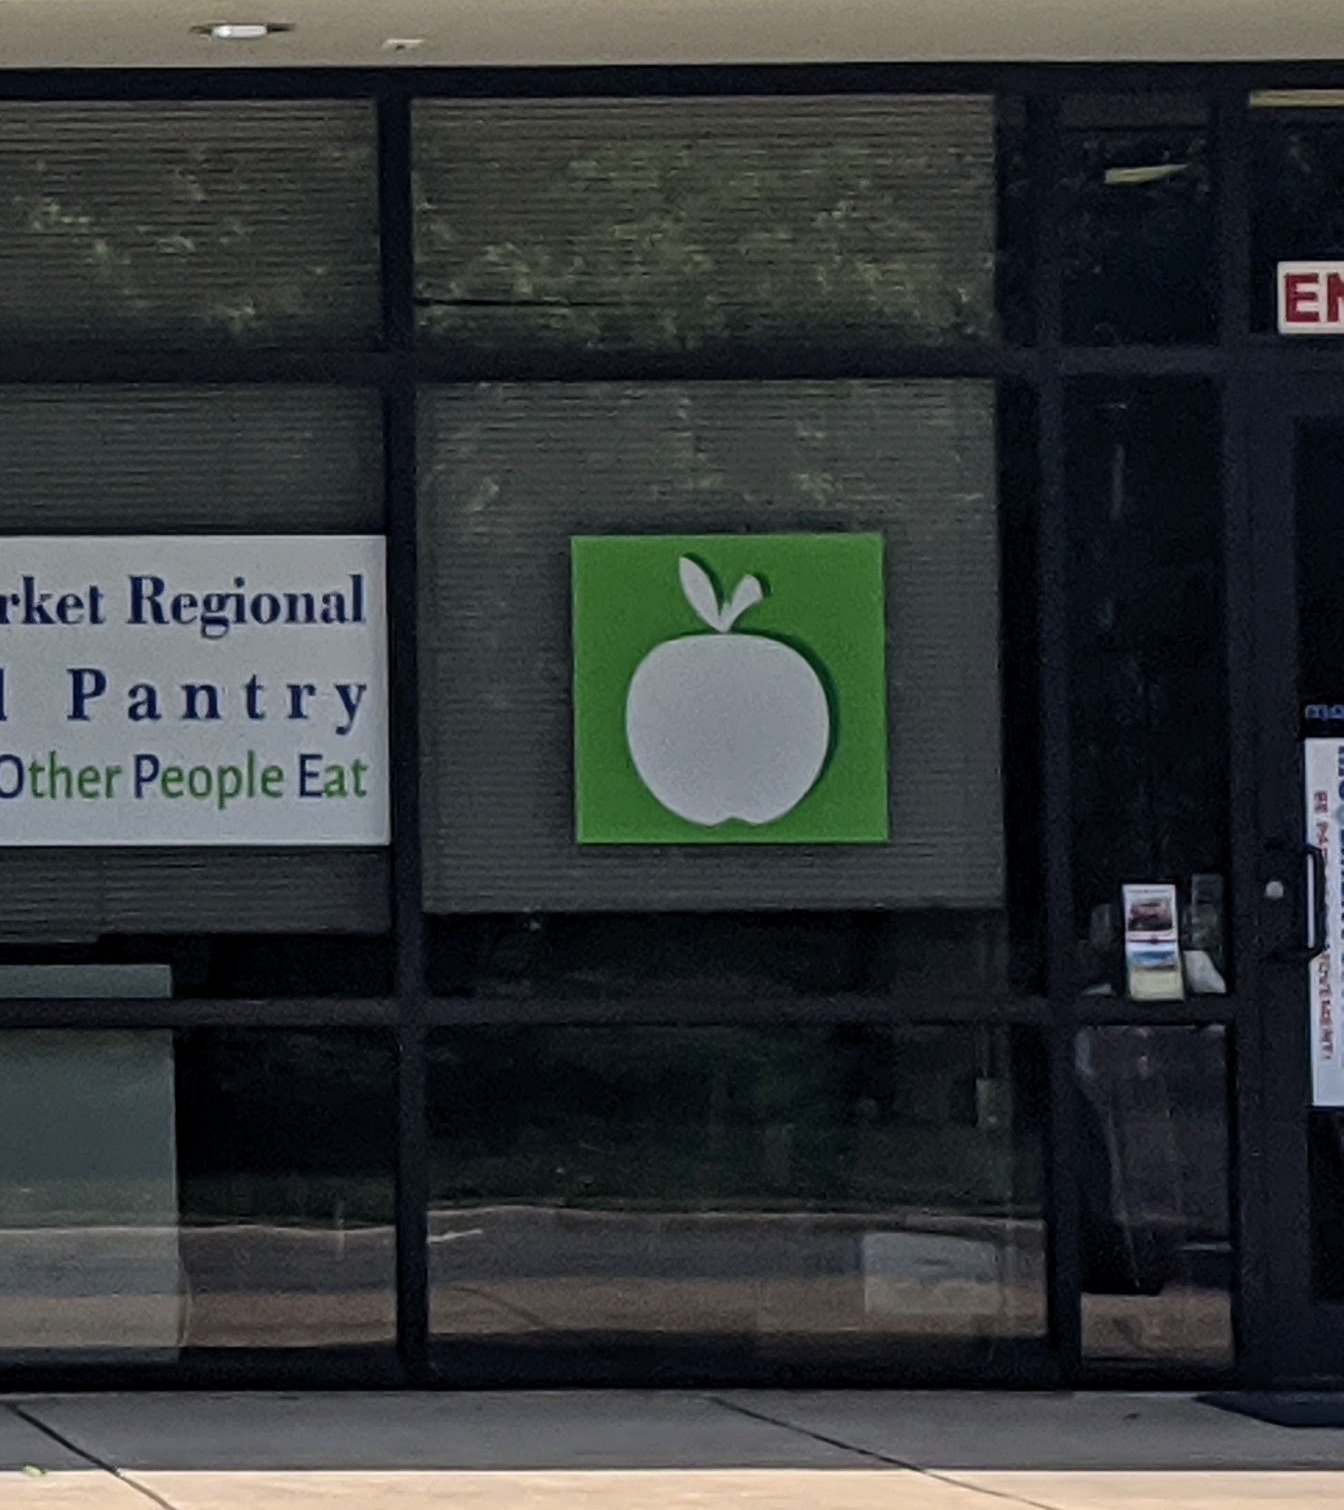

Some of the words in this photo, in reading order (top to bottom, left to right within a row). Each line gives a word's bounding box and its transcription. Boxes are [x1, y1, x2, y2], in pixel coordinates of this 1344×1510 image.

[127, 574, 367, 640] Regional
[67, 667, 368, 735] Pantry
[134, 750, 284, 810] People
[298, 752, 369, 799] Eat
